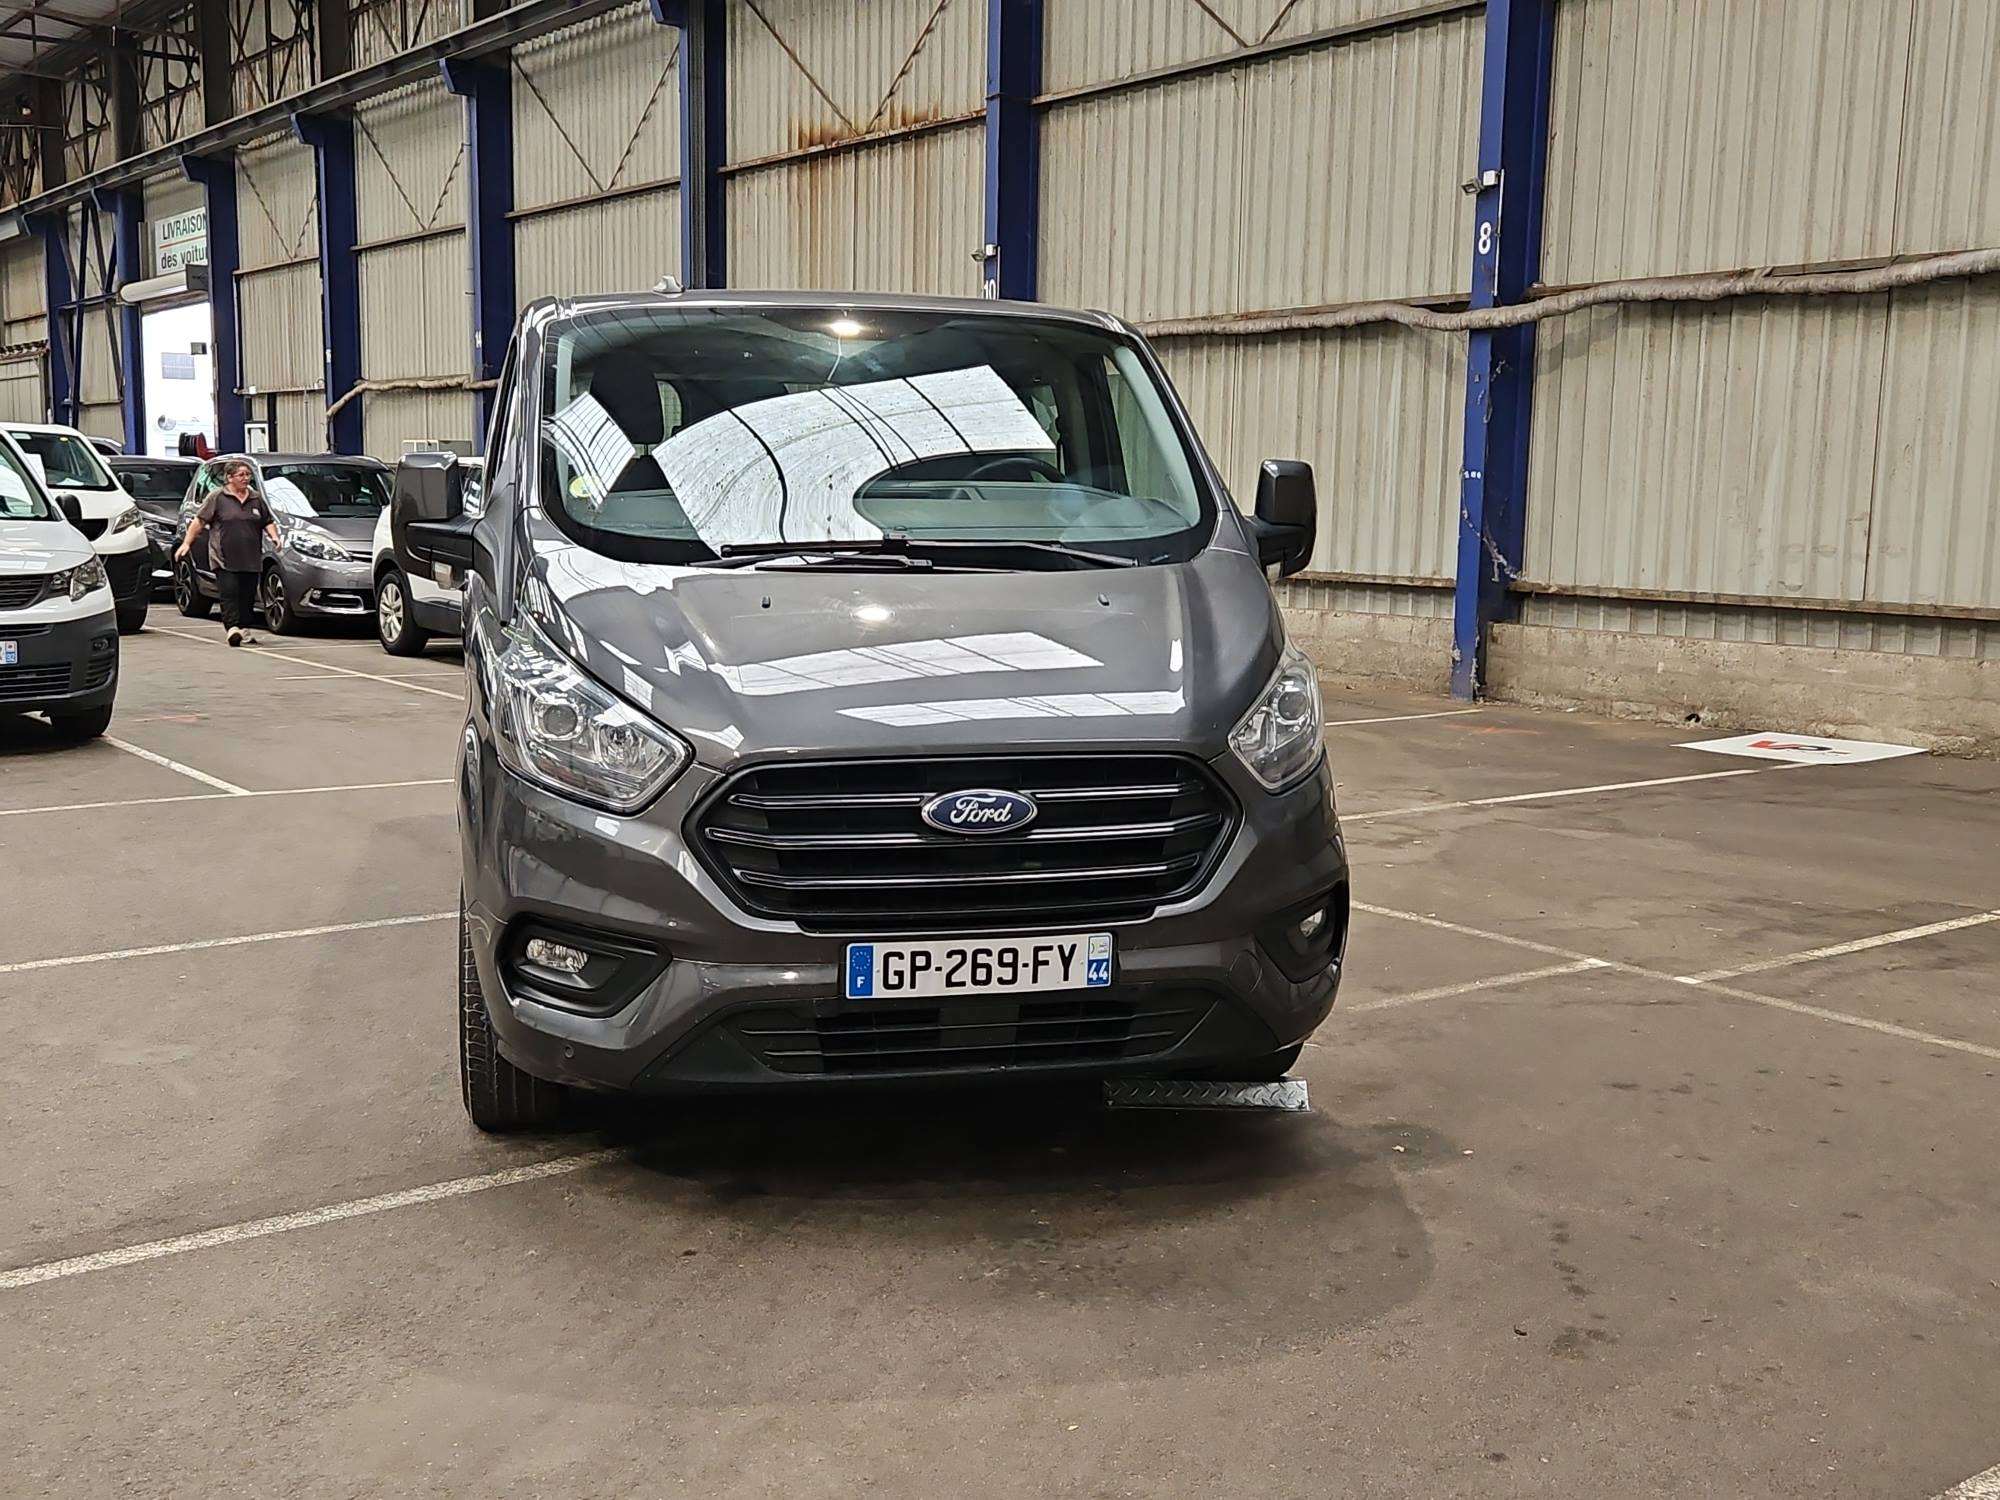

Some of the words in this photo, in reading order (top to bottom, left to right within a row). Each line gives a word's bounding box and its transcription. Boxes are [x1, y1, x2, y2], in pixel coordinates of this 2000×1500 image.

[162, 213, 208, 240] LIVRAISON
[1478, 221, 1492, 255] 8
[161, 252, 177, 269] des
[983, 278, 997, 300] 10
[949, 796, 1013, 824] Ford
[856, 976, 865, 988] F
[881, 942, 1078, 991] GP-269-FY
[1088, 961, 1108, 981] 44
